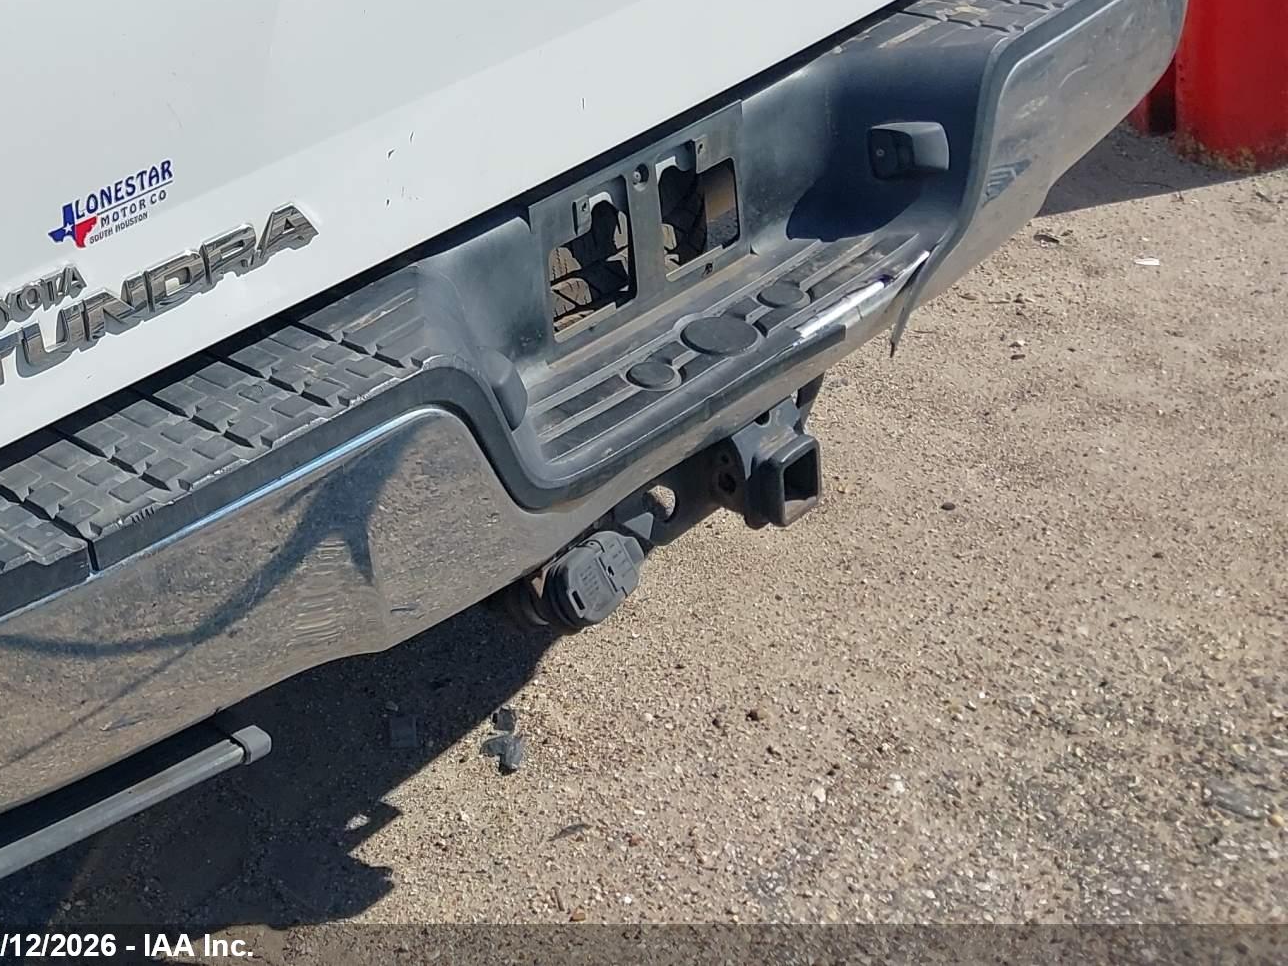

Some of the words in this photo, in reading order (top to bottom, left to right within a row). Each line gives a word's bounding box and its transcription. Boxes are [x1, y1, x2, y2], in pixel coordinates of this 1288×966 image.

[75, 159, 173, 220] LONESTAR
[100, 198, 147, 228] MOTOR
[150, 189, 167, 205] CO
[89, 227, 114, 244] SOUTH
[115, 211, 148, 233] HOUSTON
